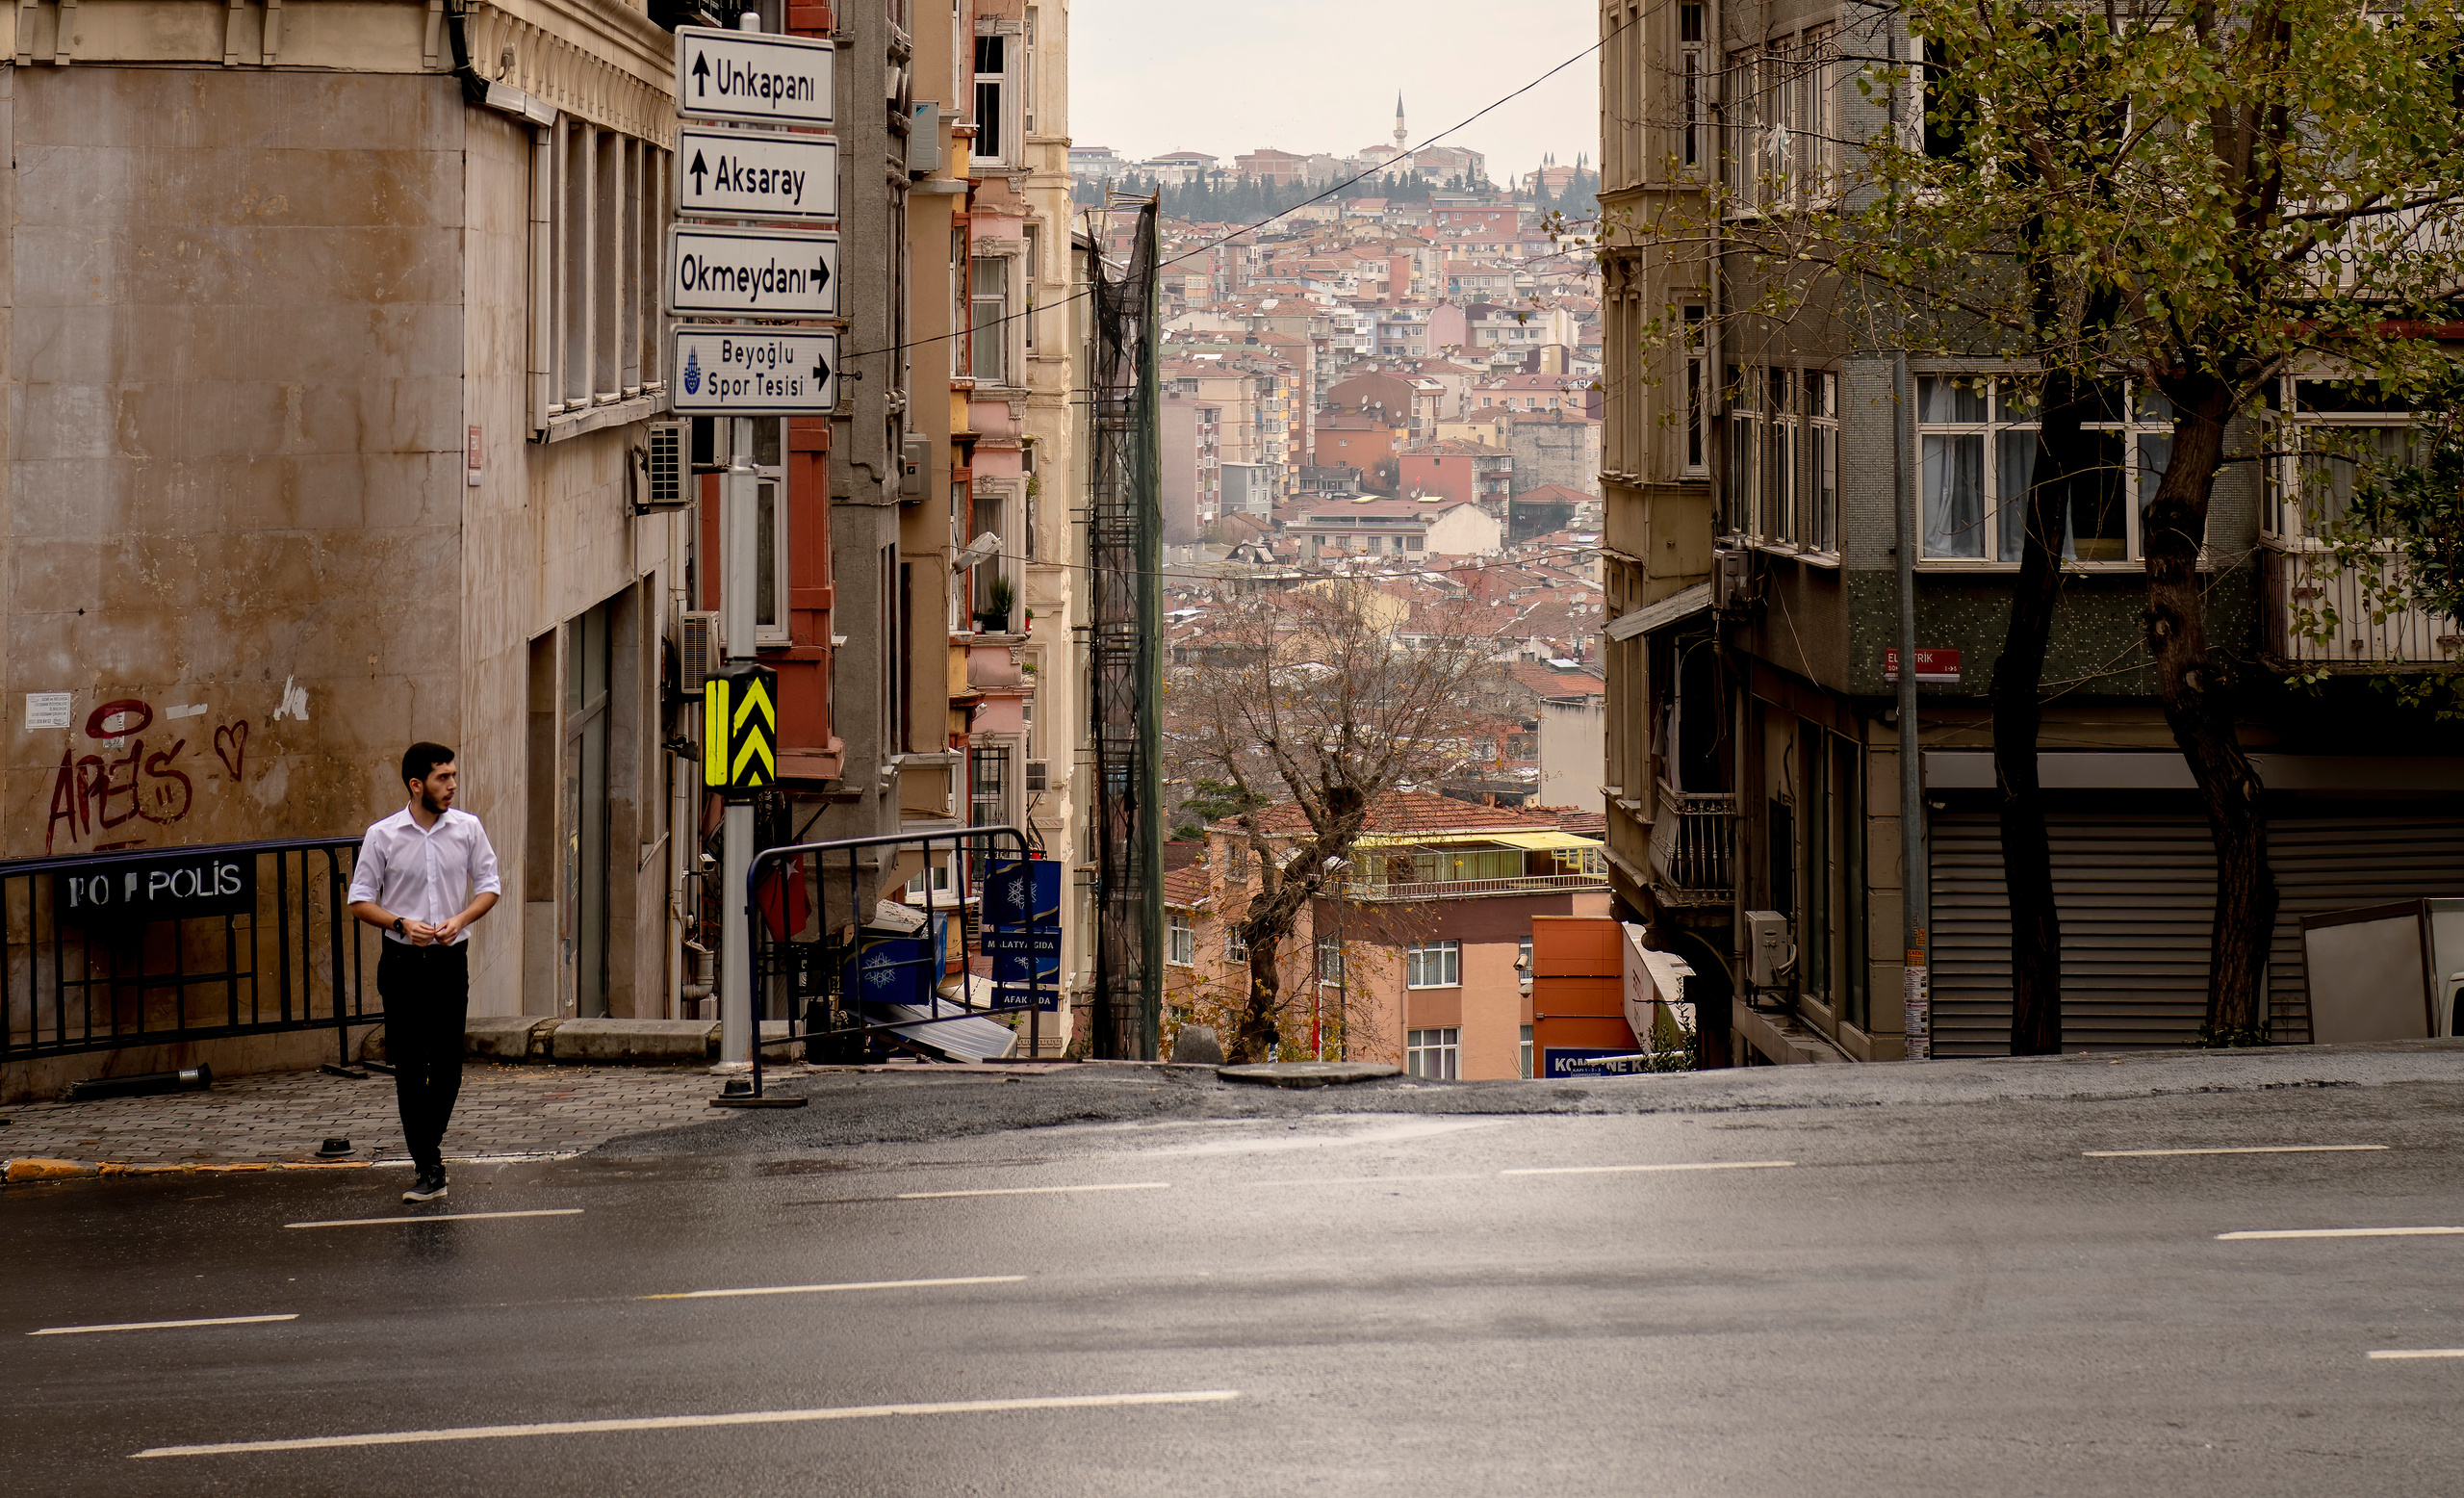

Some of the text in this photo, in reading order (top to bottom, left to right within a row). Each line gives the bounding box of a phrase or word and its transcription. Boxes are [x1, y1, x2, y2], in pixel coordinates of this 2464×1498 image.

[717, 58, 814, 109] Unkapanı
[715, 155, 806, 205] Aksaray
[680, 253, 807, 302] Okmeydanı
[722, 339, 793, 370] Beyoğlu
[708, 372, 803, 402] Spor Tesisi
[148, 860, 242, 900] POLİS
[1034, 941, 1054, 949] GIDA
